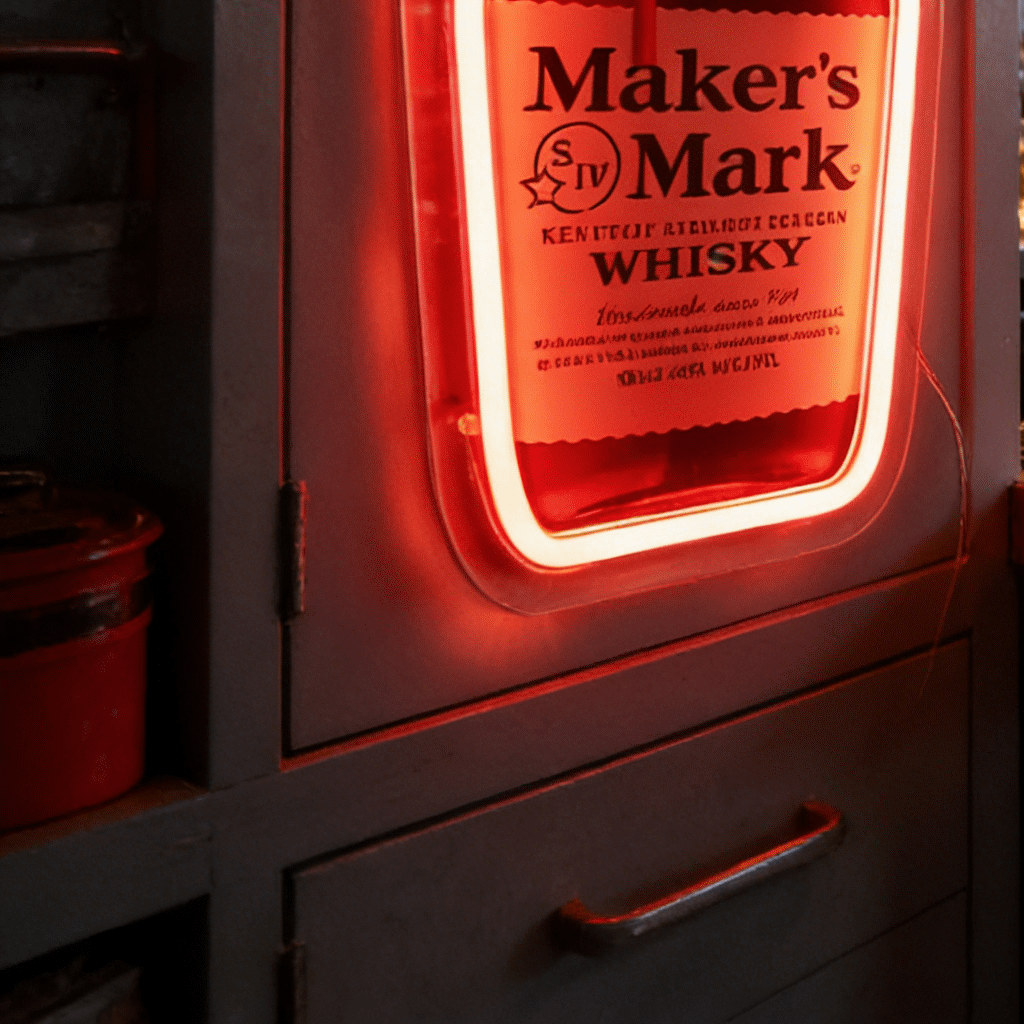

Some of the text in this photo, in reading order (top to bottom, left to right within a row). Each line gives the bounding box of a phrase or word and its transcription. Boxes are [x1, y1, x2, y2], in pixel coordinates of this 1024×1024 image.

[523, 46, 861, 113] Maker's
[551, 139, 574, 166] S
[574, 161, 609, 190] IV
[625, 127, 856, 200] Mark
[589, 236, 812, 287] WHISKY
